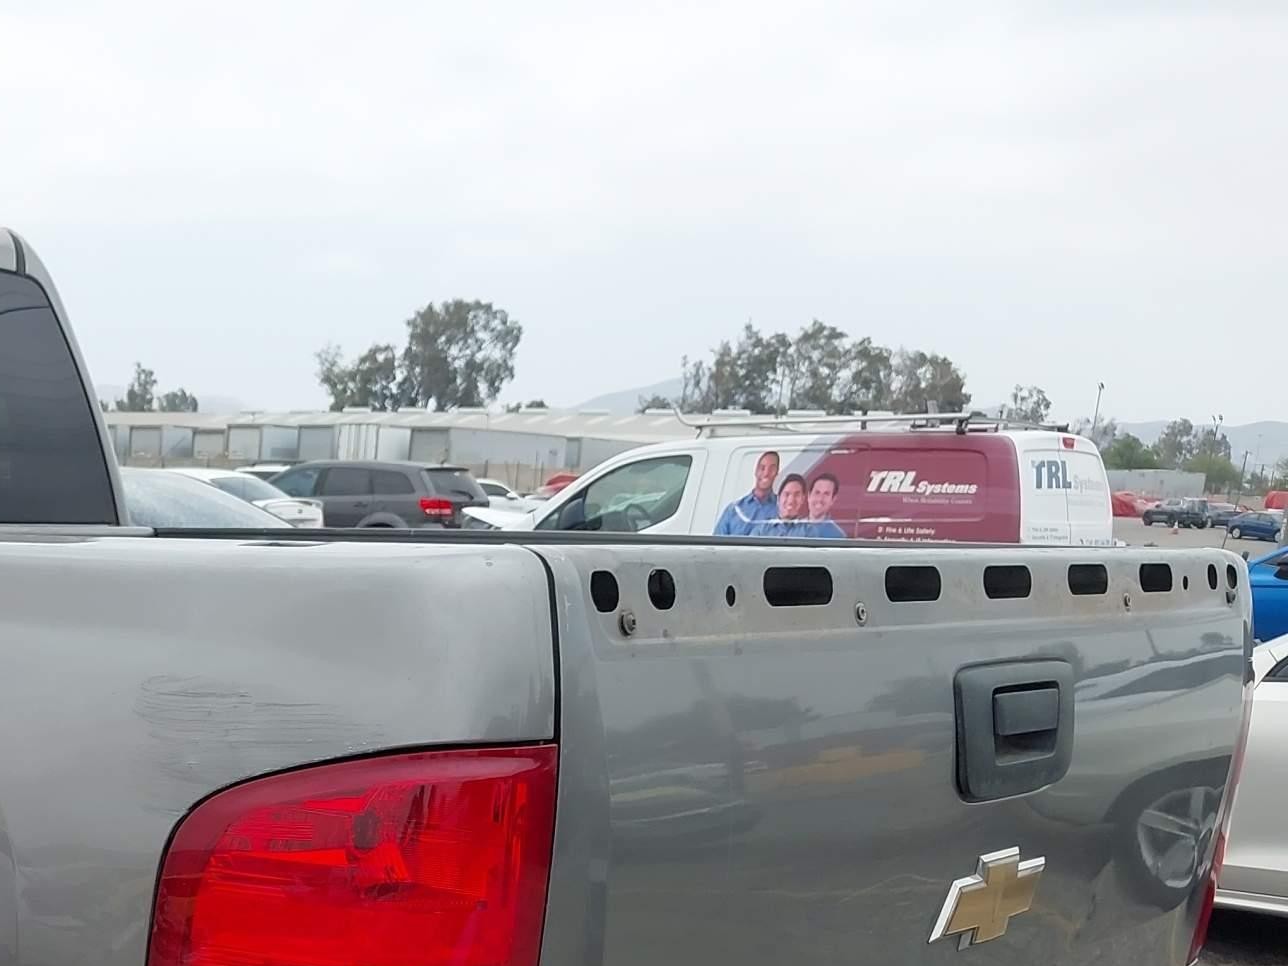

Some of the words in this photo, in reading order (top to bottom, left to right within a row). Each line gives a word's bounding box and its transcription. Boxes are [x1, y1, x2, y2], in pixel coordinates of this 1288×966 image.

[867, 470, 916, 492] TRL
[916, 480, 978, 496] Systems
[1031, 460, 1072, 489] TRL
